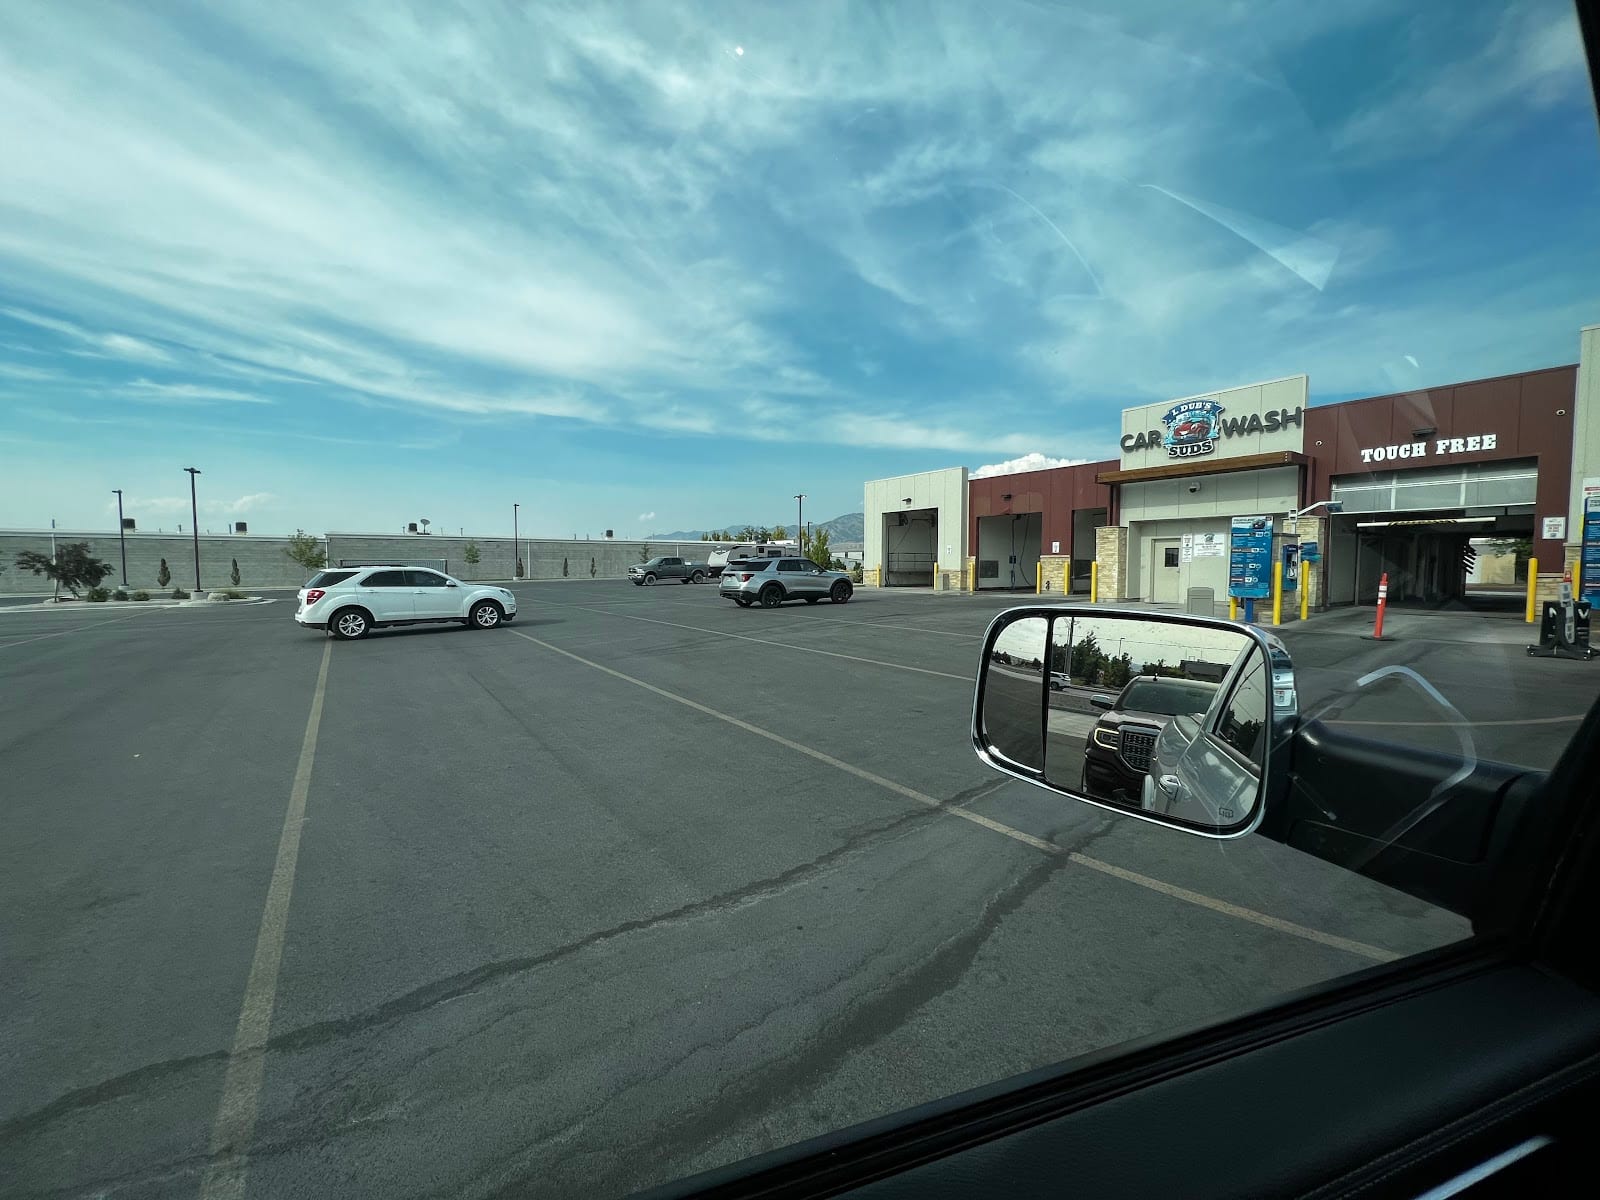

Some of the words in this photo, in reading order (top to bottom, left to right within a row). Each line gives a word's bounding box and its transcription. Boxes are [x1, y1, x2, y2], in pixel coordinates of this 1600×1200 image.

[1120, 430, 1162, 453] CAR
[1222, 406, 1303, 438] WASH
[1168, 440, 1213, 457] SUDS
[1361, 442, 1426, 463] TOUCH
[1436, 434, 1497, 455] FREE
